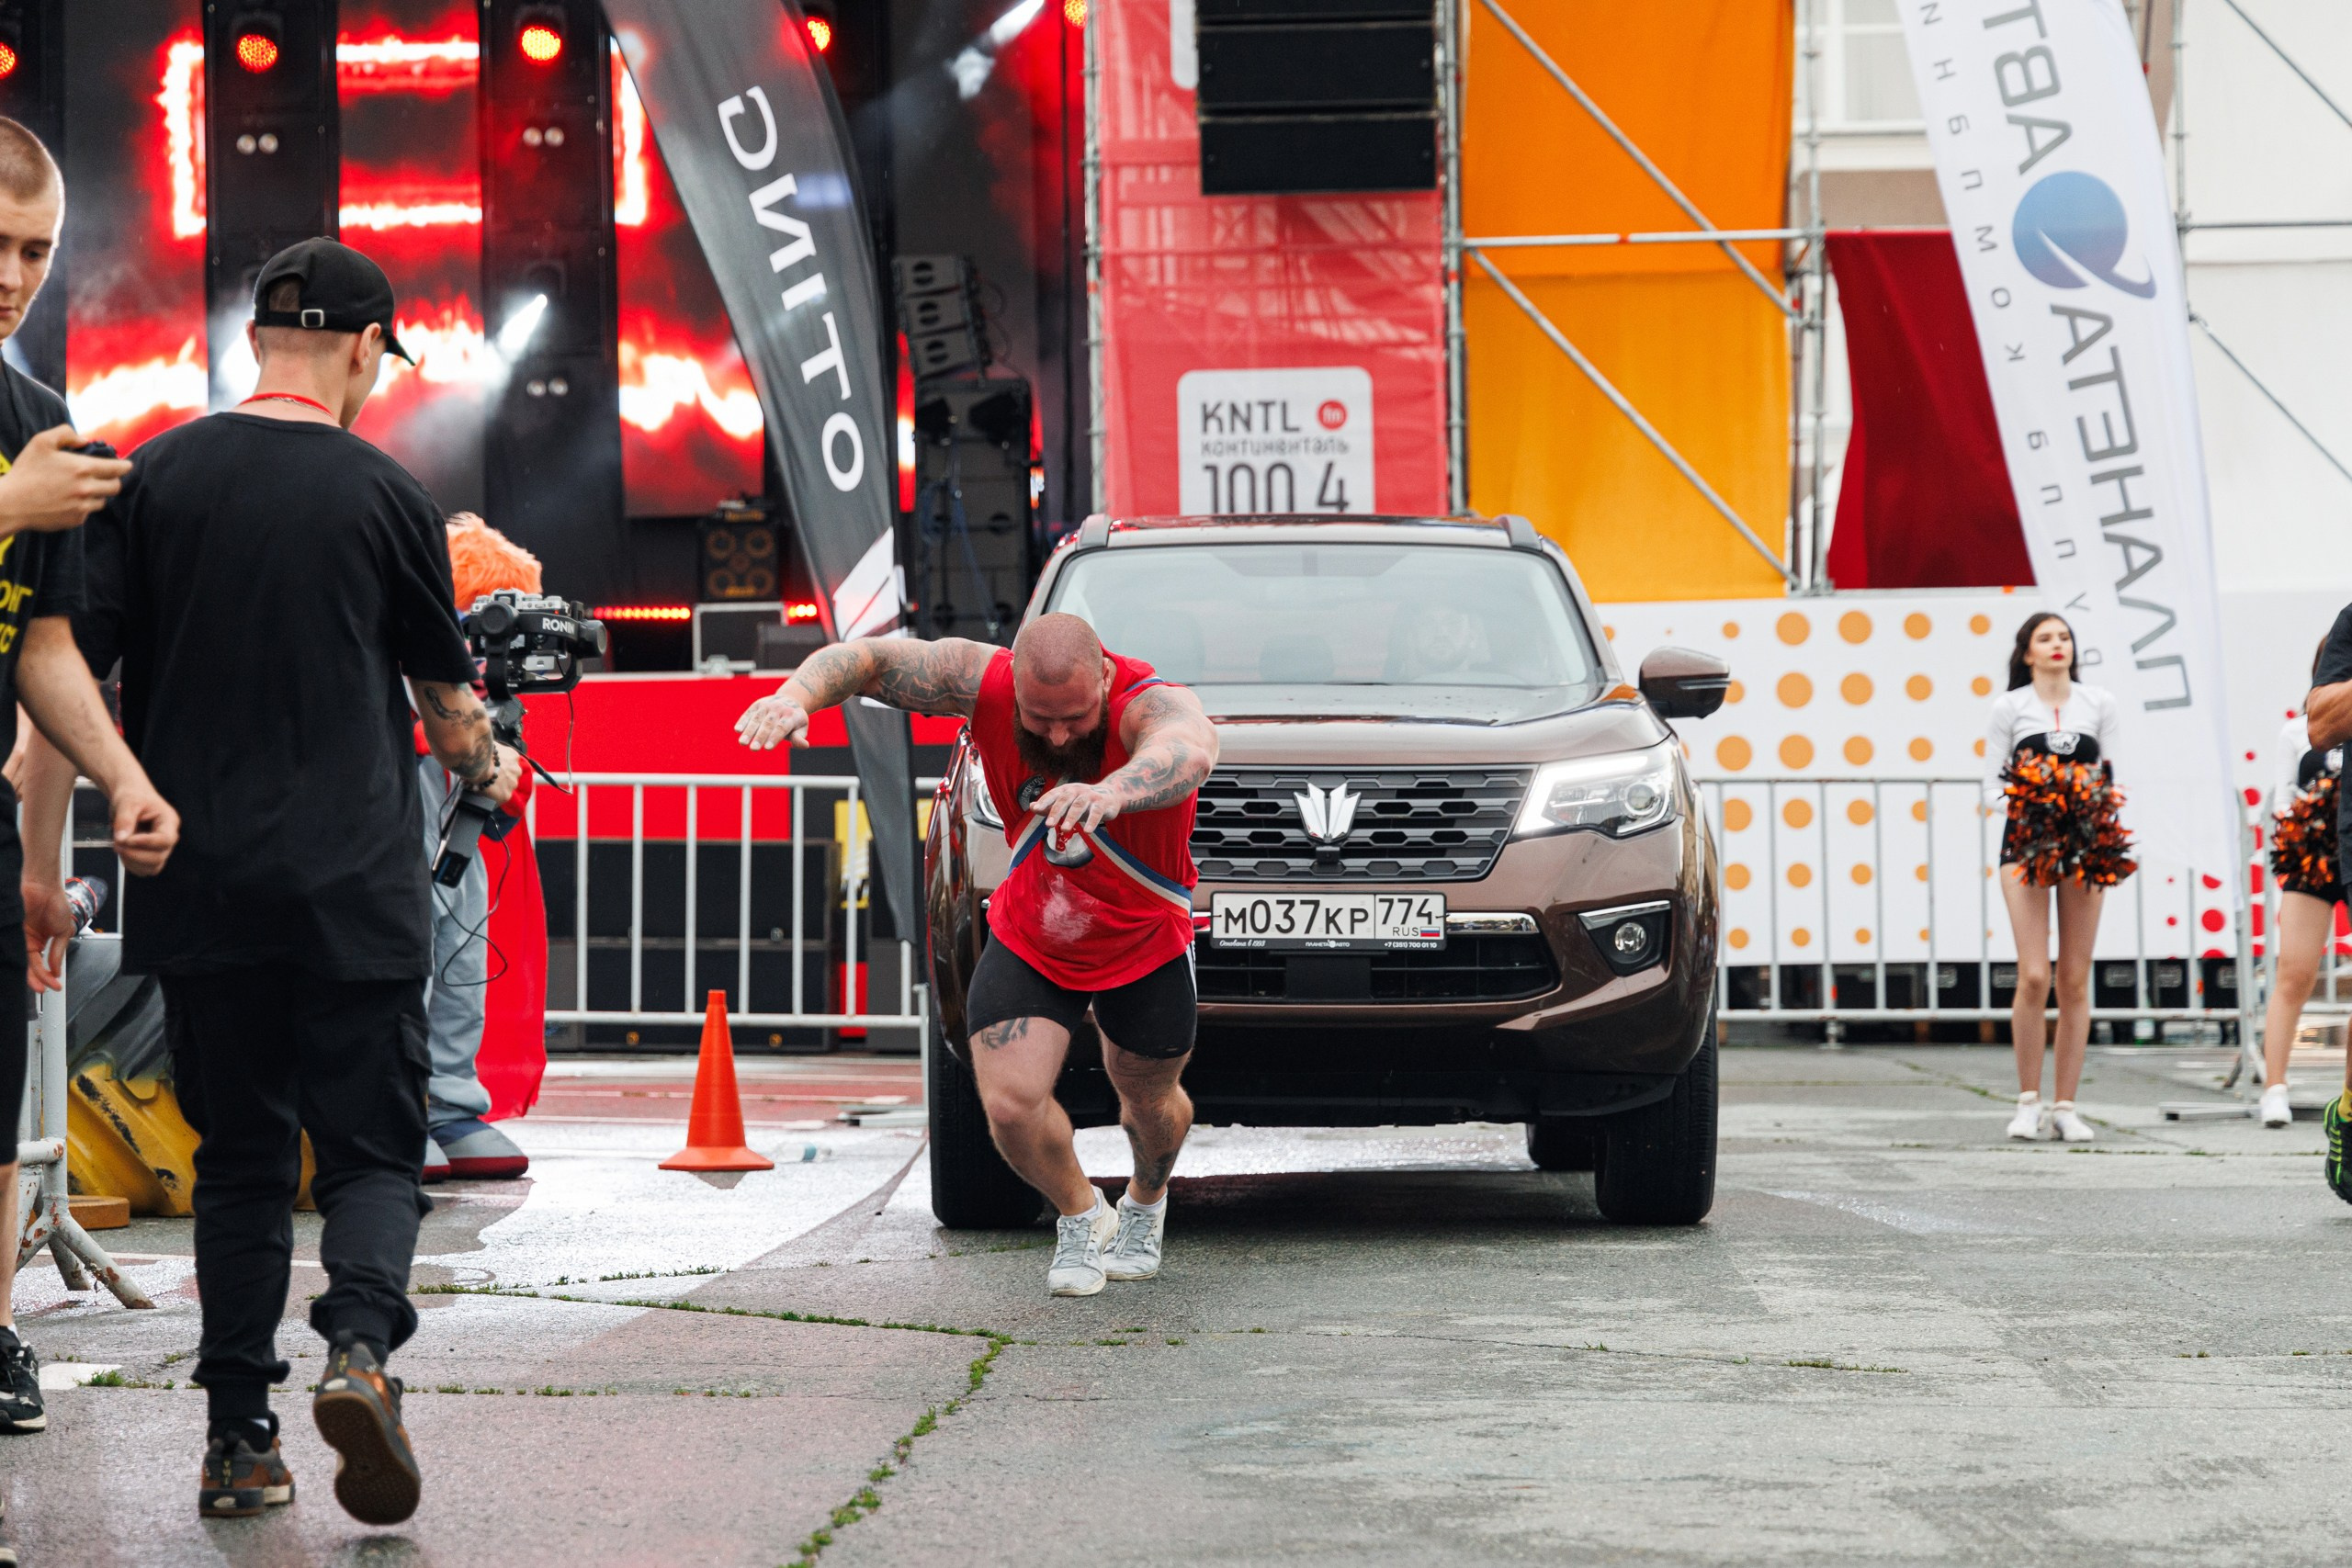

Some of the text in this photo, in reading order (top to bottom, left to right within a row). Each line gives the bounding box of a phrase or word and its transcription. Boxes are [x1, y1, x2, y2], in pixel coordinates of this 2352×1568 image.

[1201, 400, 1301, 434] KNTL
[542, 616, 575, 635] RONIN
[1378, 897, 1433, 925] 774
[1392, 926, 1419, 937] RUS
